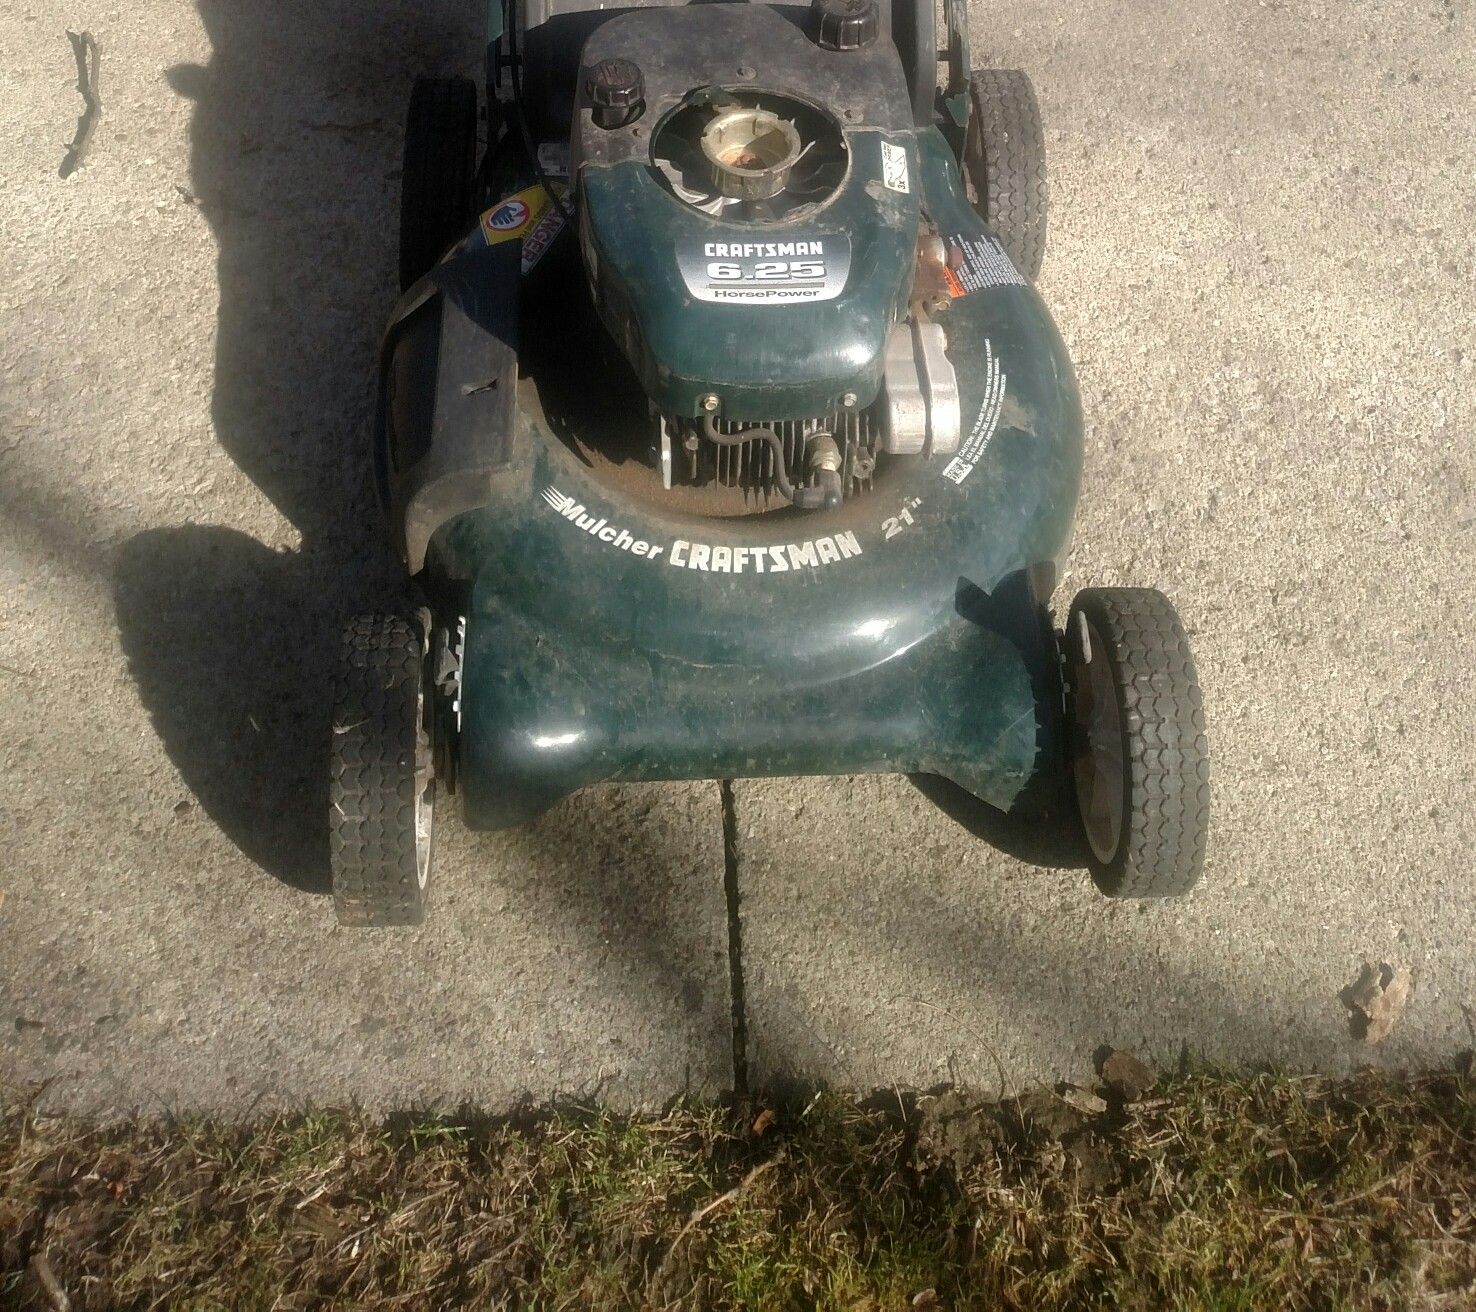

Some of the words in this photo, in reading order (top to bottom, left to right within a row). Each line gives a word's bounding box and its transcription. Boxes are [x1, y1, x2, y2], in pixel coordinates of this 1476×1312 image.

[704, 241, 824, 257] CRAFTSMAN
[706, 261, 827, 280] 6.25
[714, 290, 820, 298] HorsePower
[558, 496, 663, 561] Mulcher
[669, 530, 862, 574] CRAFTSMAN
[880, 497, 923, 541] 21"
